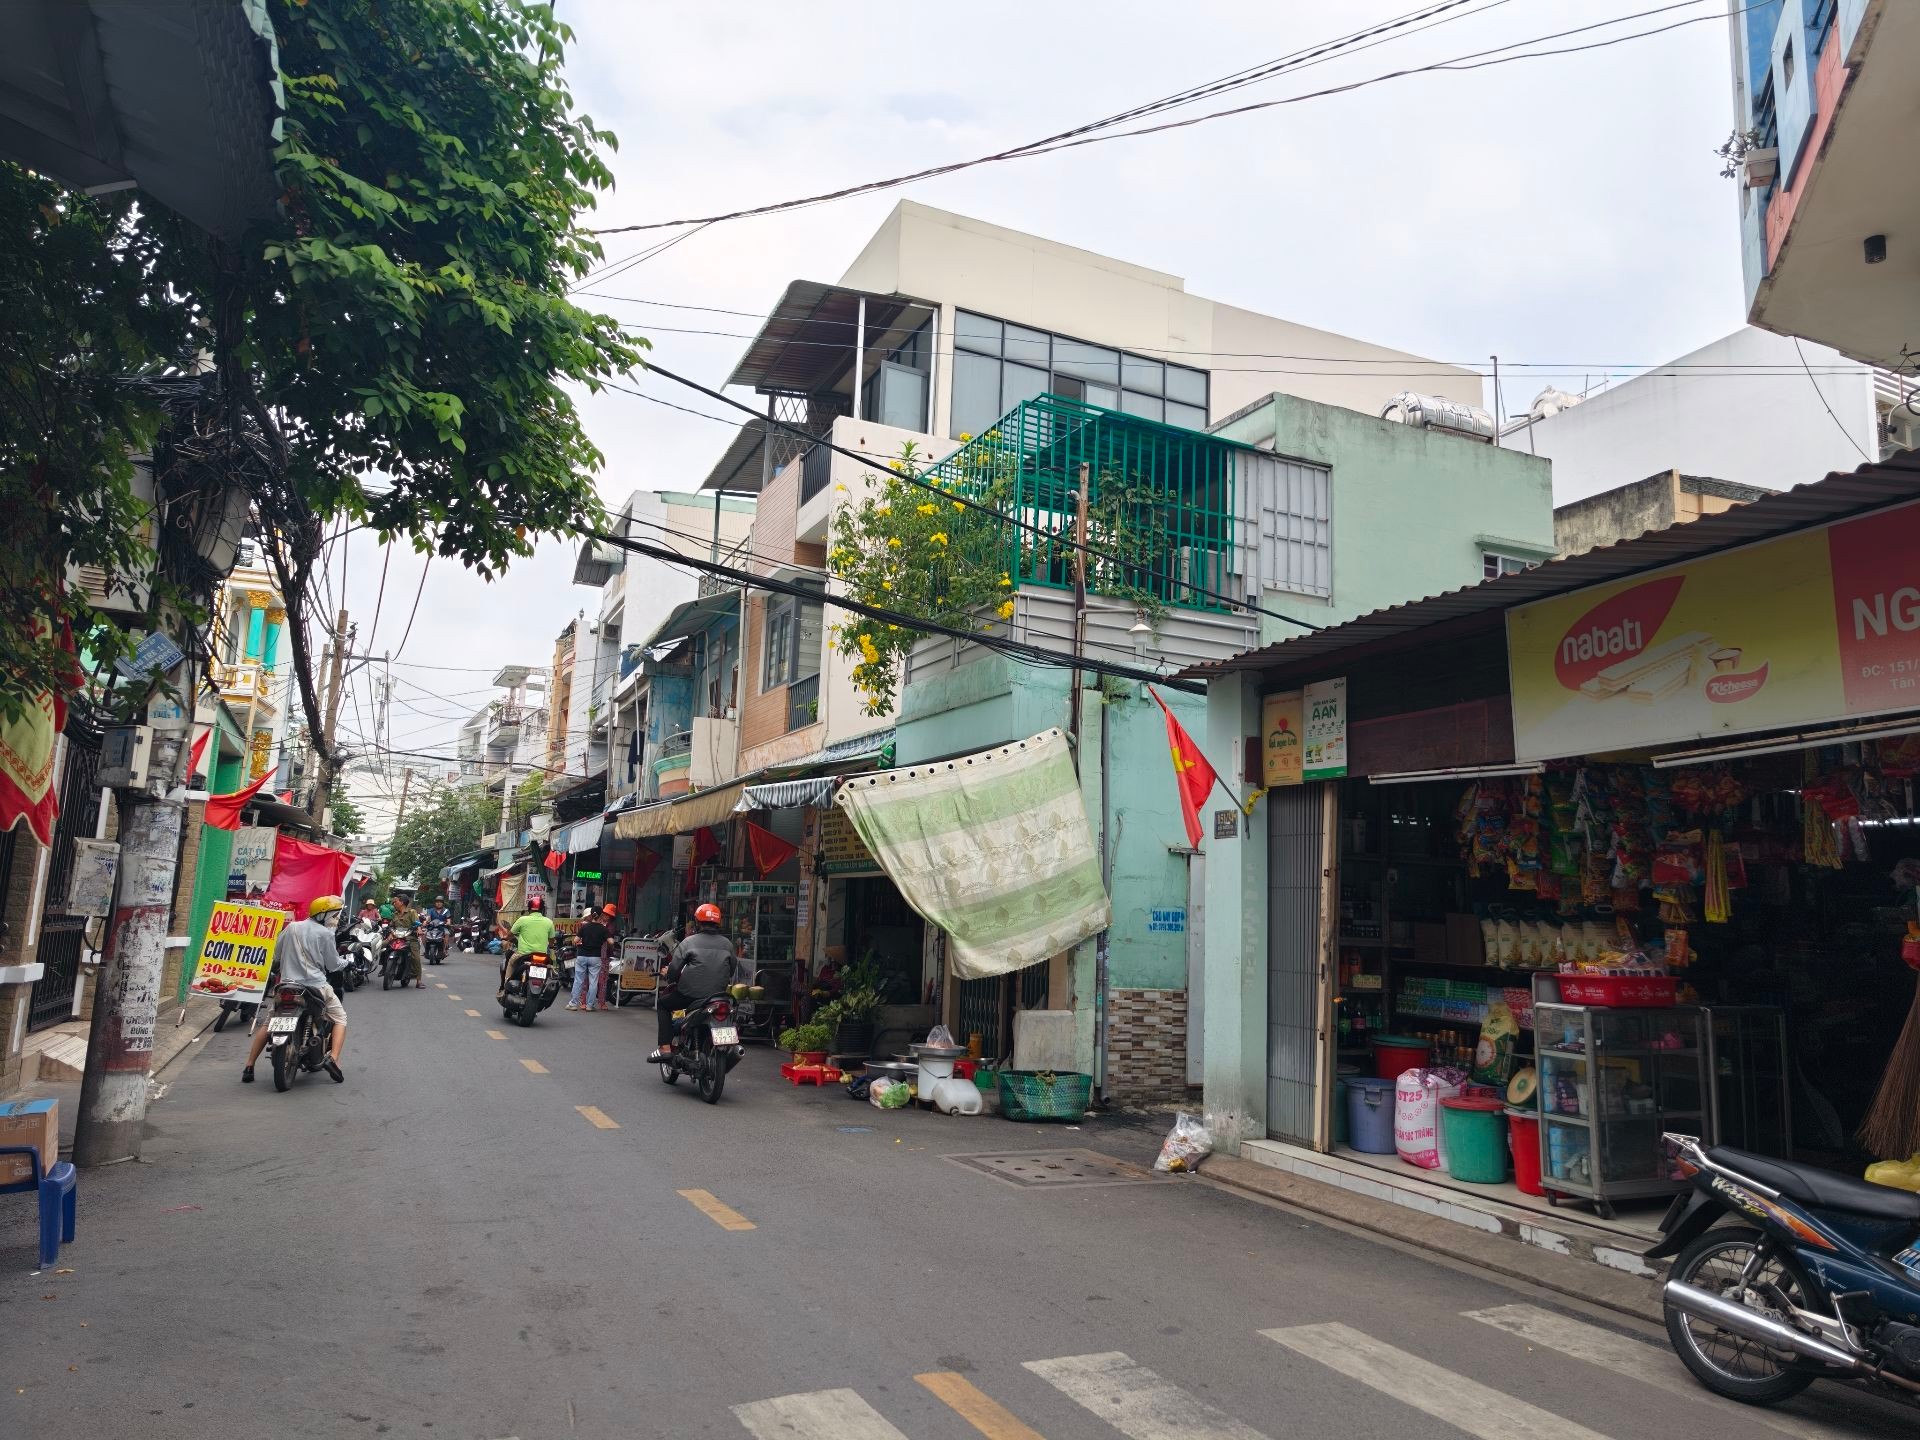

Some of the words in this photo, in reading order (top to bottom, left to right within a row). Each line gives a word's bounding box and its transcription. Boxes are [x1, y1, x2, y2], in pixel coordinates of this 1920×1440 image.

[1562, 617, 1642, 666] nabati
[210, 907, 254, 936] QUÁN
[203, 938, 234, 961] CƠM
[235, 945, 268, 966] TRƯA
[201, 962, 260, 980] 30-35K
[1398, 1089, 1423, 1102] ST25
